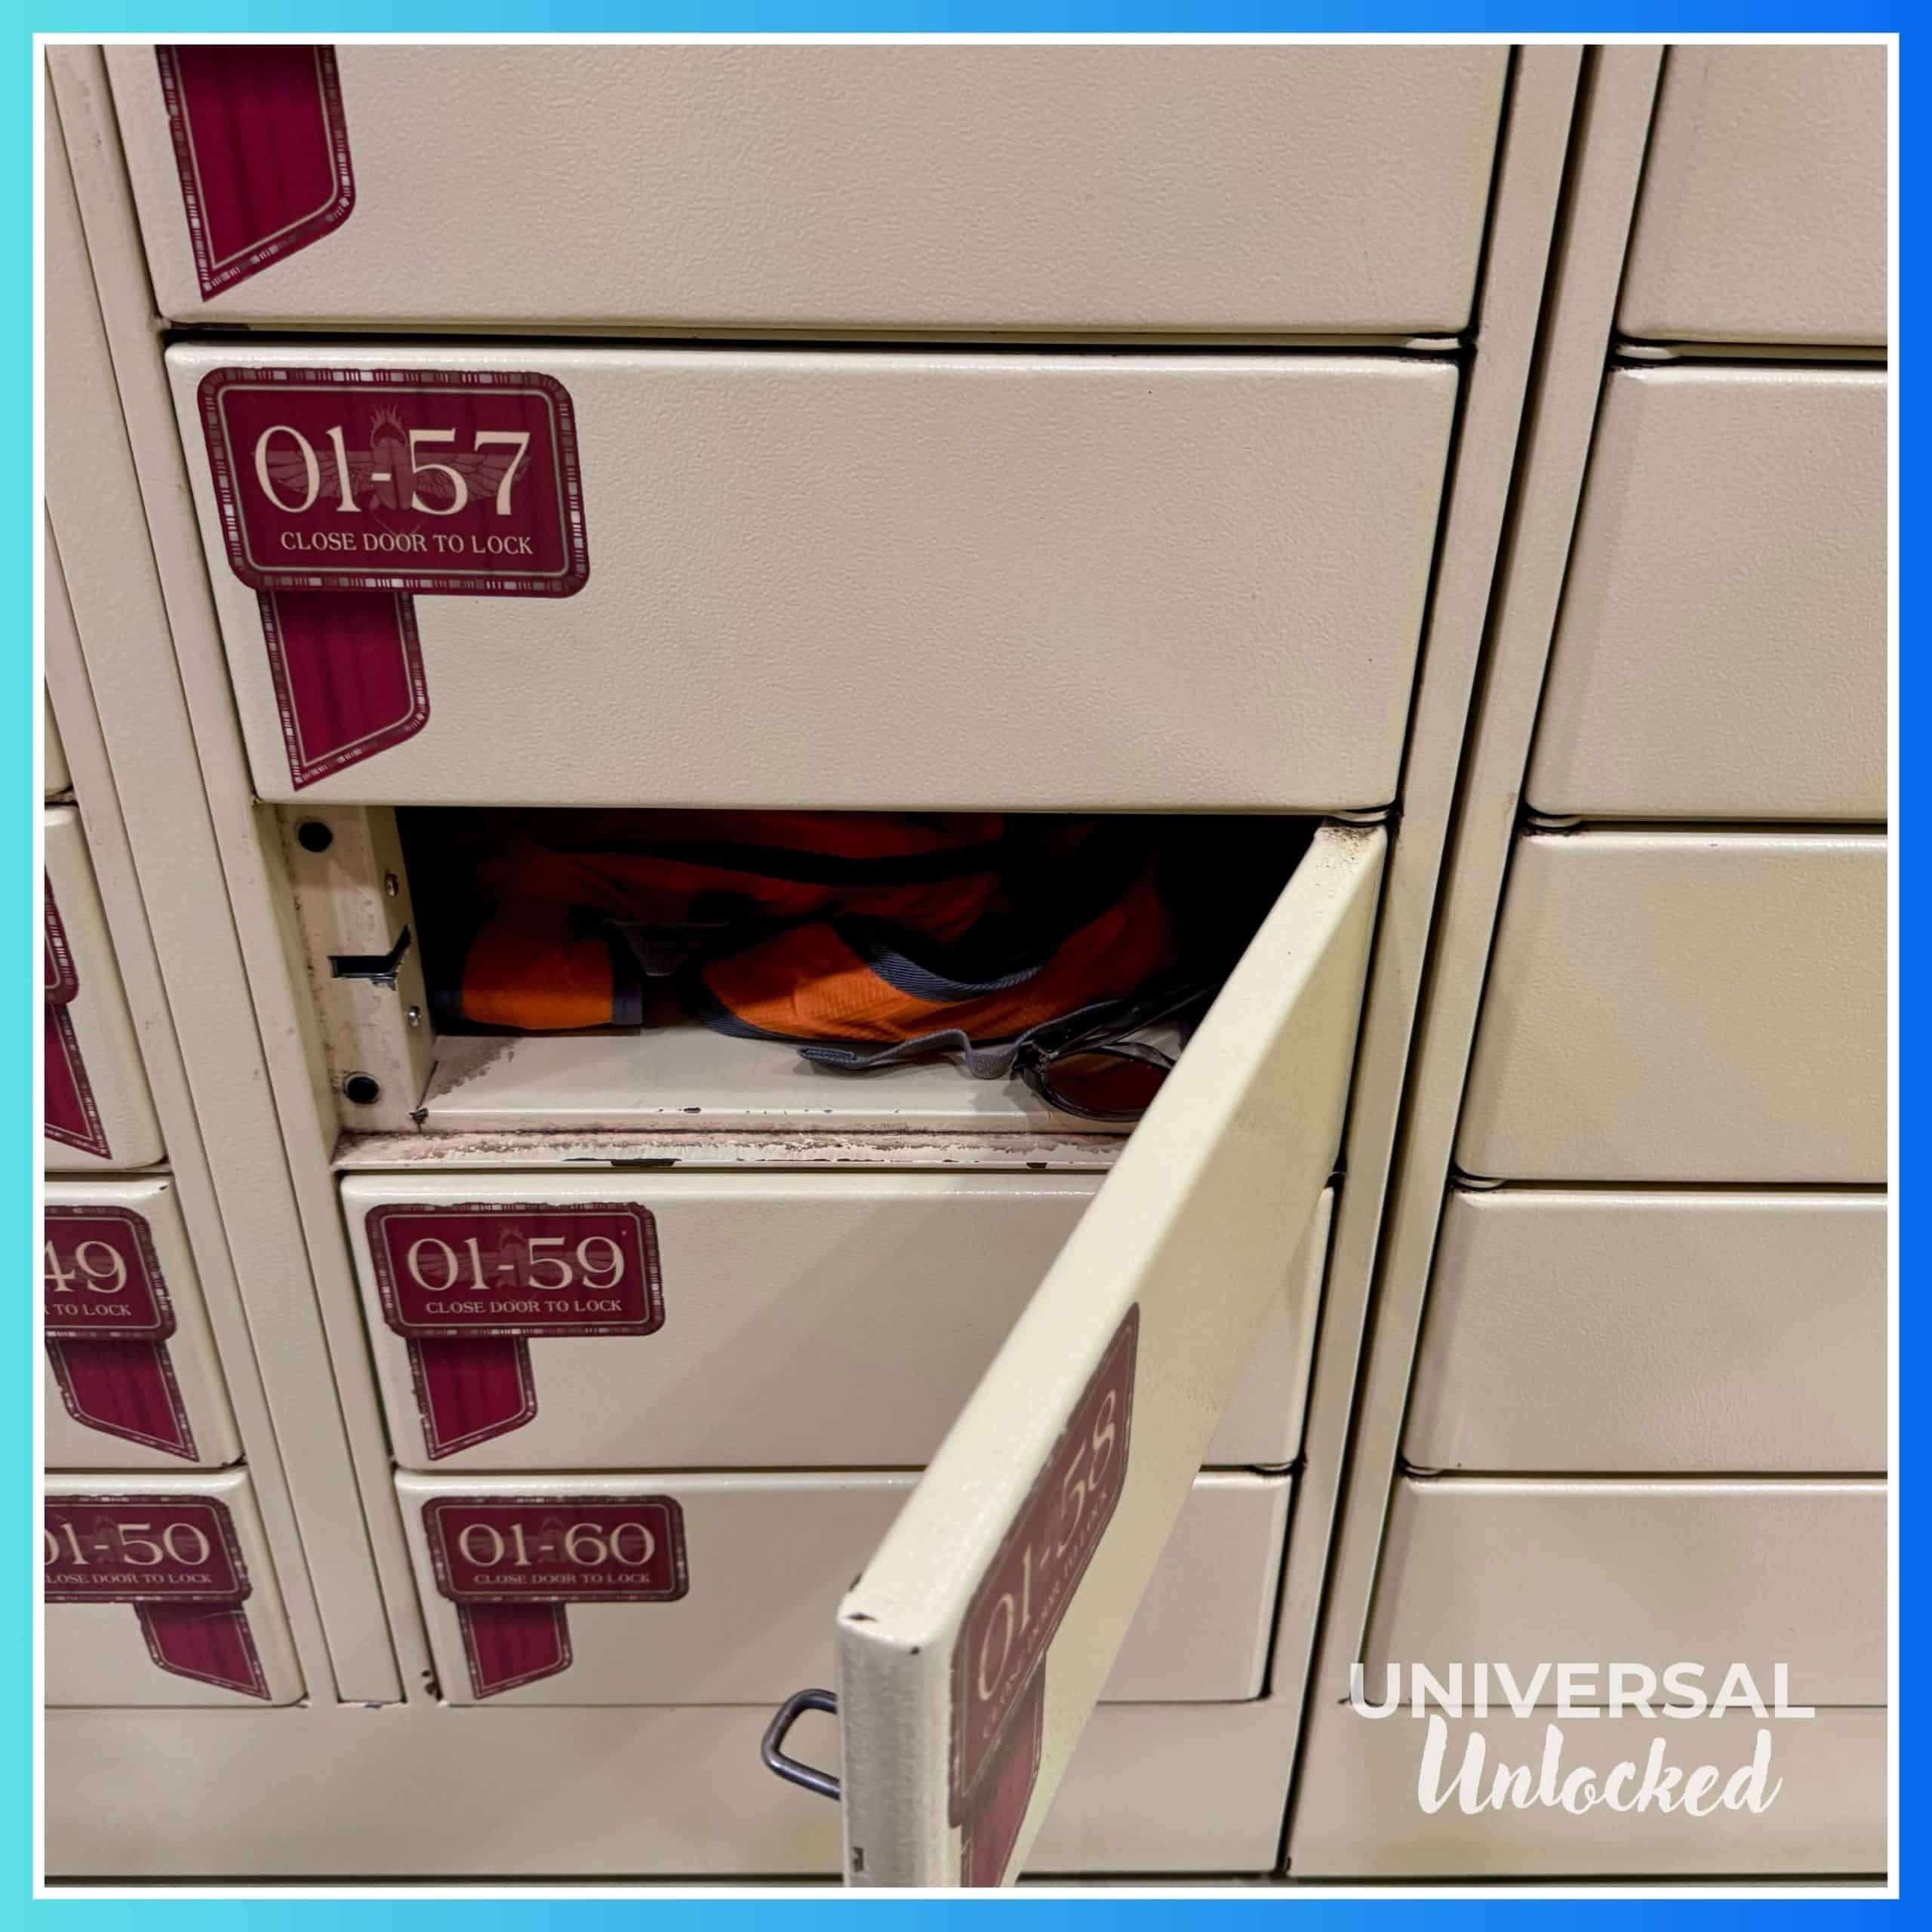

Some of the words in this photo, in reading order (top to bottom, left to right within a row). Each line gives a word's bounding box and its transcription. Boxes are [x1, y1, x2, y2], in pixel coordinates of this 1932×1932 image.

[254, 425, 531, 515] 01-57
[280, 531, 357, 552] CLOSE
[363, 532, 428, 553] DOOR
[432, 534, 466, 555] TO
[471, 535, 534, 555] LOCK
[407, 1235, 625, 1291] 01-59
[52, 1303, 78, 1316] TO
[82, 1303, 132, 1316] LOCK
[425, 1300, 486, 1315] CLOSE
[491, 1300, 542, 1314] DOOR
[544, 1300, 569, 1313] TO
[574, 1298, 623, 1312] LOCK
[458, 1522, 656, 1567] 01-60
[978, 1389, 1116, 1701] 01-58
[45, 1573, 88, 1585] LOSE
[92, 1573, 139, 1584] DOOR
[142, 1573, 165, 1584] TO
[168, 1573, 214, 1584] LOCK
[473, 1574, 528, 1584] CLOSE
[531, 1573, 578, 1584] DOOR
[582, 1573, 604, 1583] TO
[607, 1572, 651, 1583] LOCK
